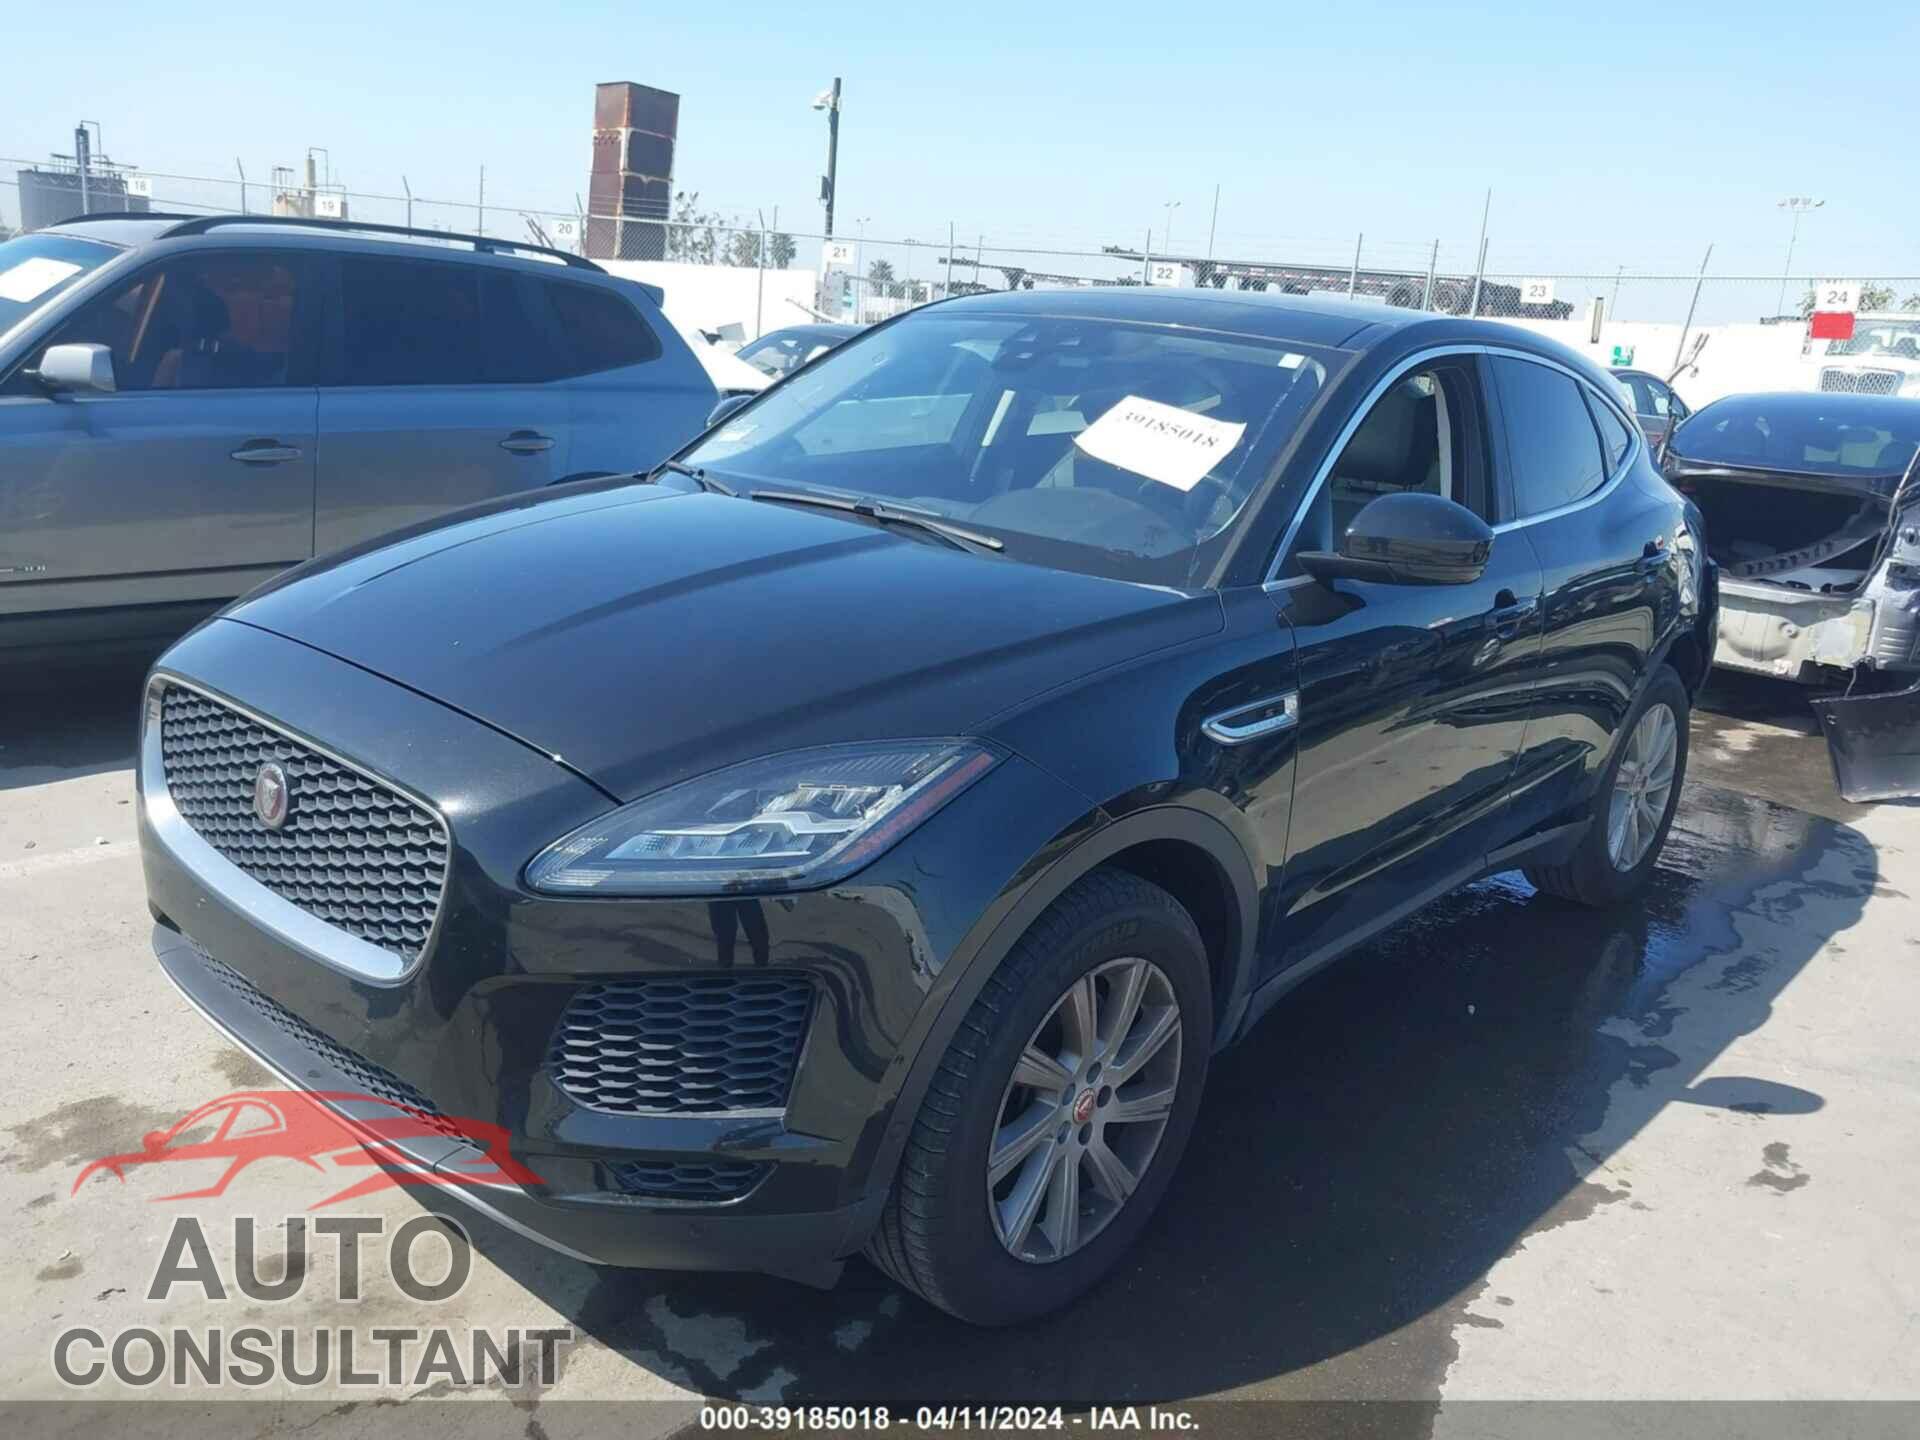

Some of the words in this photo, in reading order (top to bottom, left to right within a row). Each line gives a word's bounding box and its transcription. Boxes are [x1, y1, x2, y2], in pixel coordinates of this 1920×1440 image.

[134, 179, 147, 192] 18
[321, 200, 335, 212] 19
[557, 222, 574, 235] 20
[832, 245, 848, 258] 21
[1156, 266, 1175, 280] 22
[1528, 283, 1547, 297] 23
[1826, 289, 1849, 305] 24
